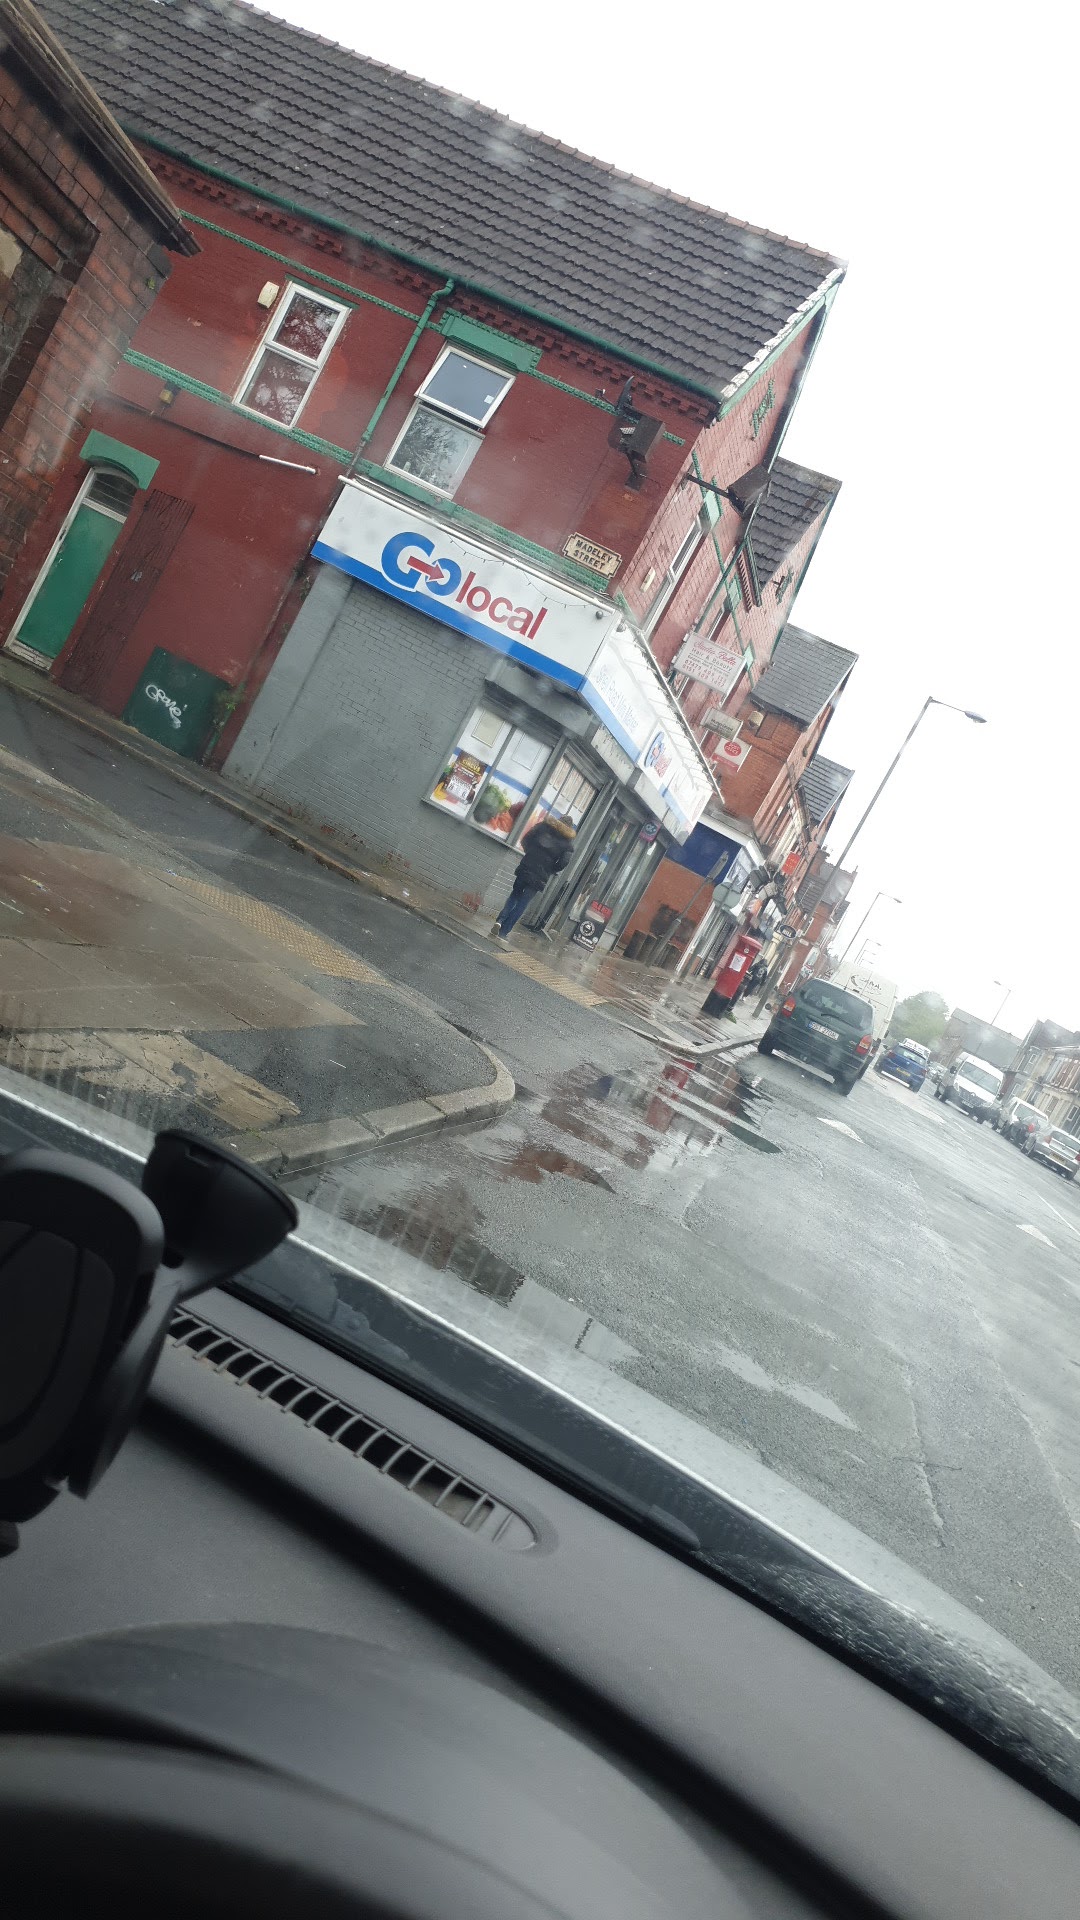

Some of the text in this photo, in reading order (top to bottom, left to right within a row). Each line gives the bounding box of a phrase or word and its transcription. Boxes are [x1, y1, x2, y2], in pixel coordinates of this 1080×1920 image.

[573, 549, 605, 569] STREET
[576, 540, 613, 563] MADELEY
[691, 648, 704, 656] Hair
[712, 658, 732, 671] Beauty
